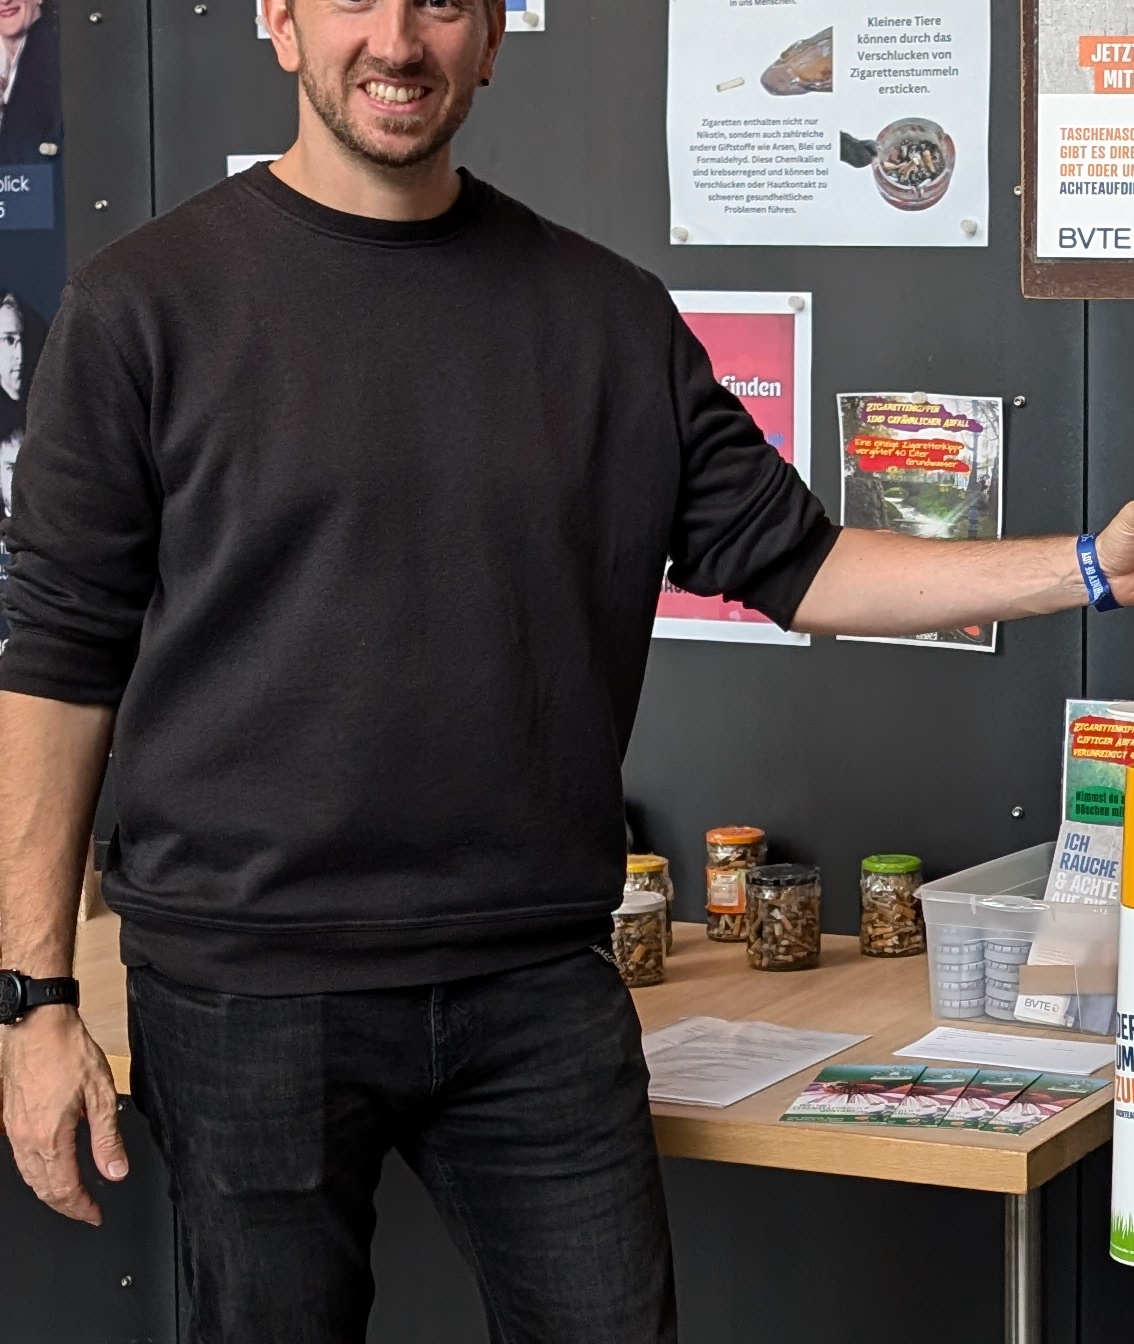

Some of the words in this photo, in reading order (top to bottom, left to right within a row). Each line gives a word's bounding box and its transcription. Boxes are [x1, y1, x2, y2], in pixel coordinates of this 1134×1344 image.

[867, 16, 912, 27] Kleinere
[913, 15, 941, 26] Tiere
[856, 33, 897, 44] können
[899, 32, 931, 43] durch
[932, 31, 952, 42] das
[856, 49, 929, 61] Verschlucken
[931, 51, 952, 59] von
[849, 65, 959, 79] Zigarettenstummeln
[878, 83, 930, 94] ersticken.
[1059, 145, 1087, 159] GIBT
[1091, 145, 1105, 159] ES
[1059, 163, 1083, 177] ORT
[1087, 163, 1118, 177] ODER
[1058, 227, 1131, 249] BVTE
[721, 375, 781, 396] finden
[1064, 832, 1091, 853] ICH
[1059, 852, 1119, 878] RAUCHE
[1055, 872, 1067, 890] &
[1071, 874, 1119, 900] ACHTE
[1024, 998, 1052, 1012] BVTE
